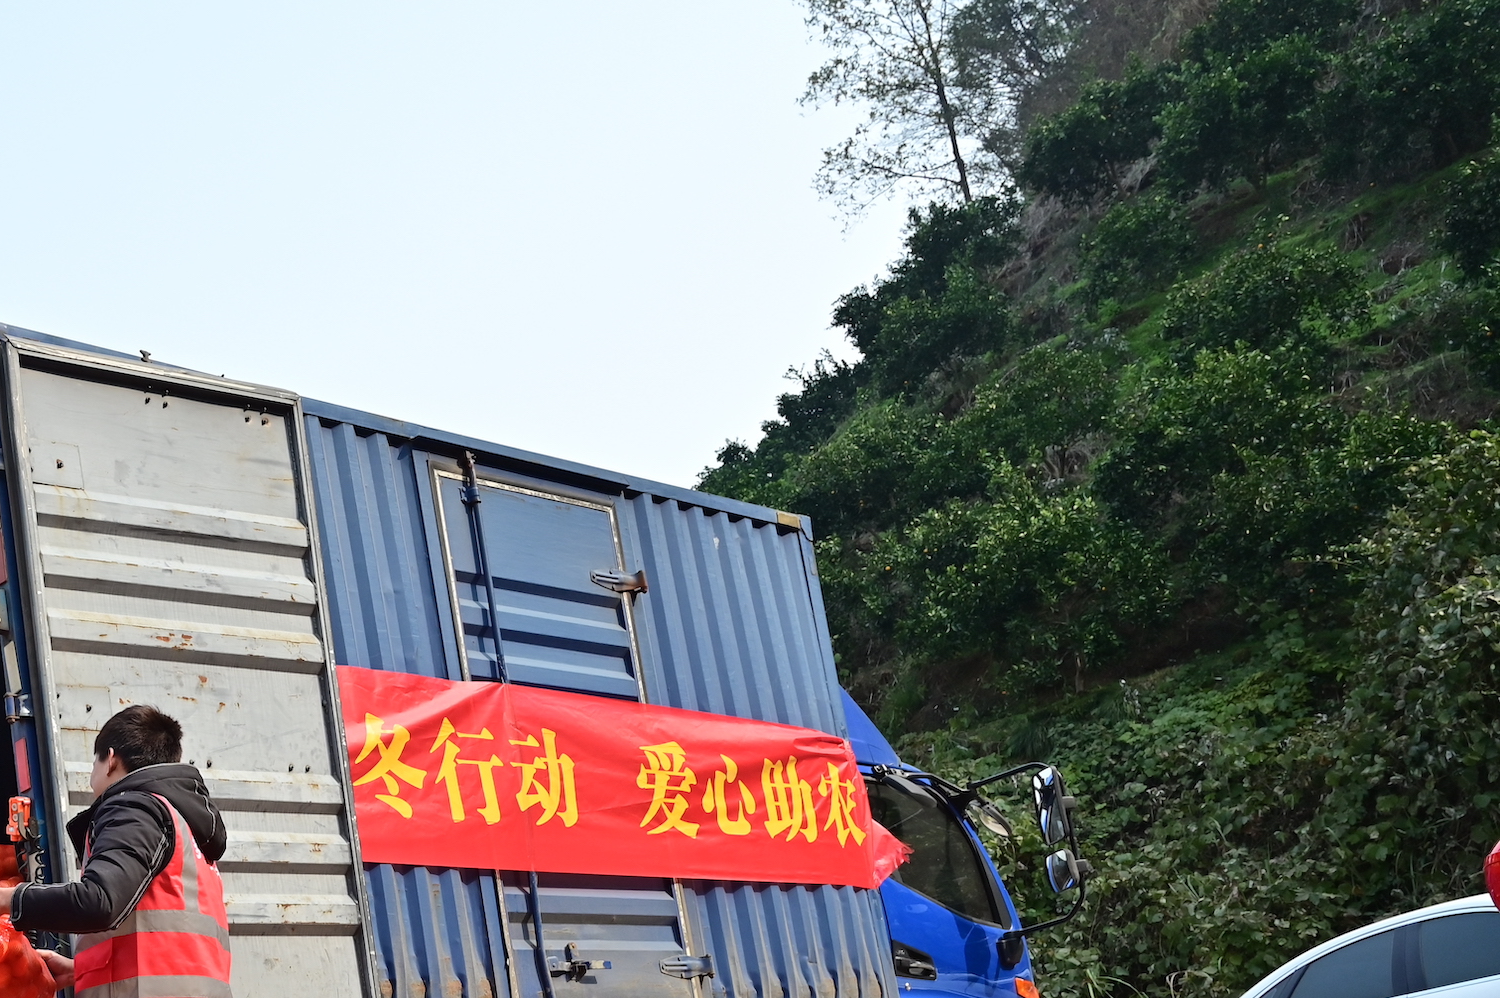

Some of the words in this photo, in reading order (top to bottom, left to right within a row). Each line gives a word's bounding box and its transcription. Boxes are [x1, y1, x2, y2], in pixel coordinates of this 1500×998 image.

[353, 711, 579, 828] 冬行动
[636, 740, 867, 848] 爱心助农
